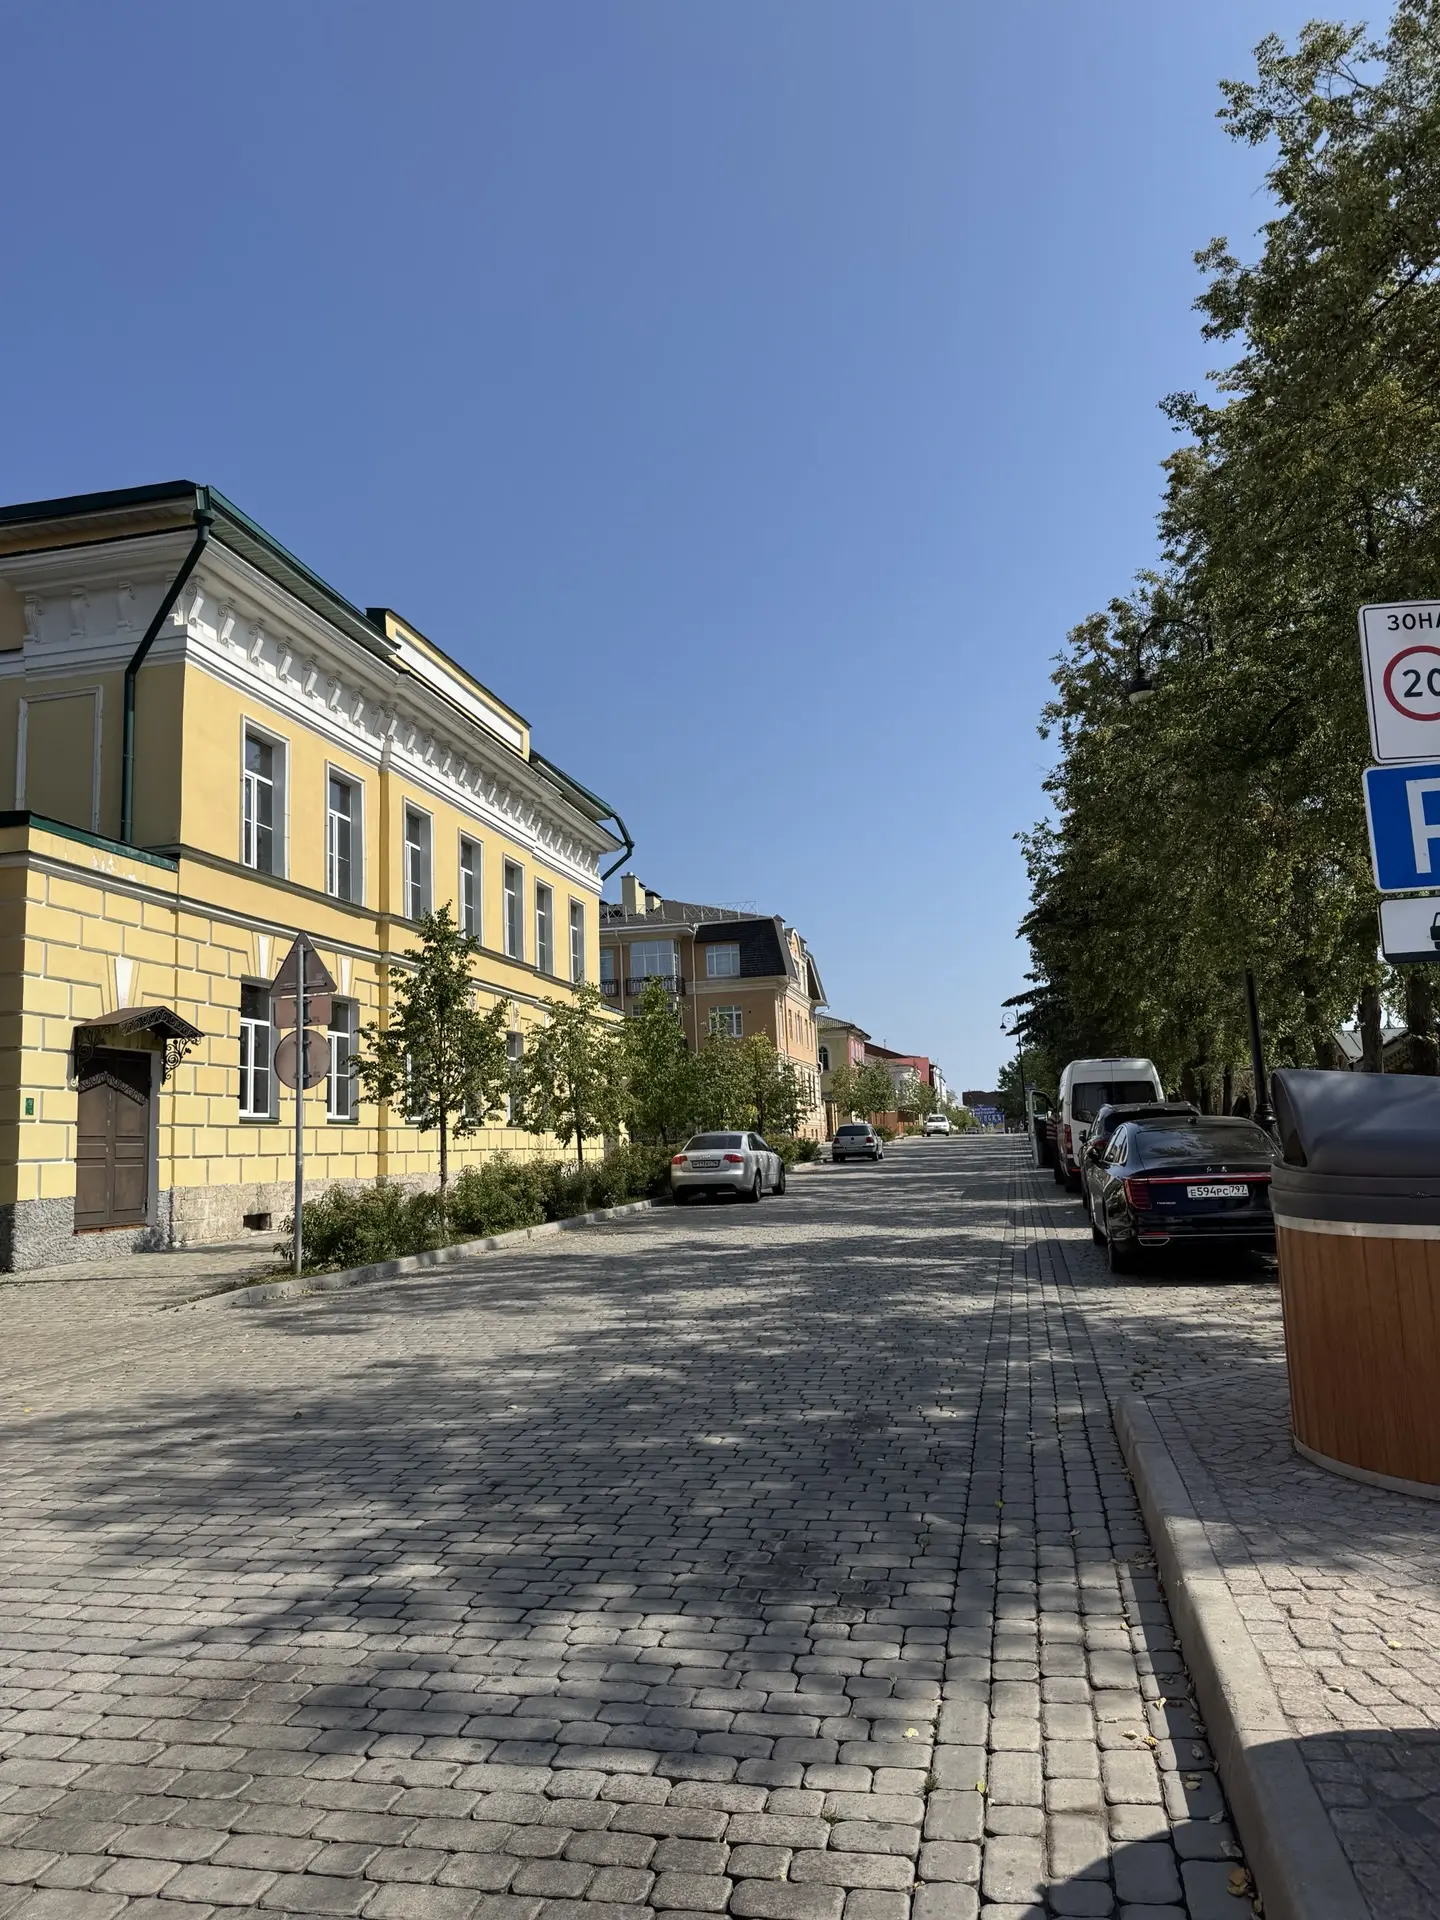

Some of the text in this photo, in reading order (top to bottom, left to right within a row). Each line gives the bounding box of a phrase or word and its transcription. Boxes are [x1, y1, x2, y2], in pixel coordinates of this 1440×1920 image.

[1387, 612, 1440, 631] ЗОН
[1402, 668, 1440, 698] 20
[1230, 1185, 1245, 1193] 797
